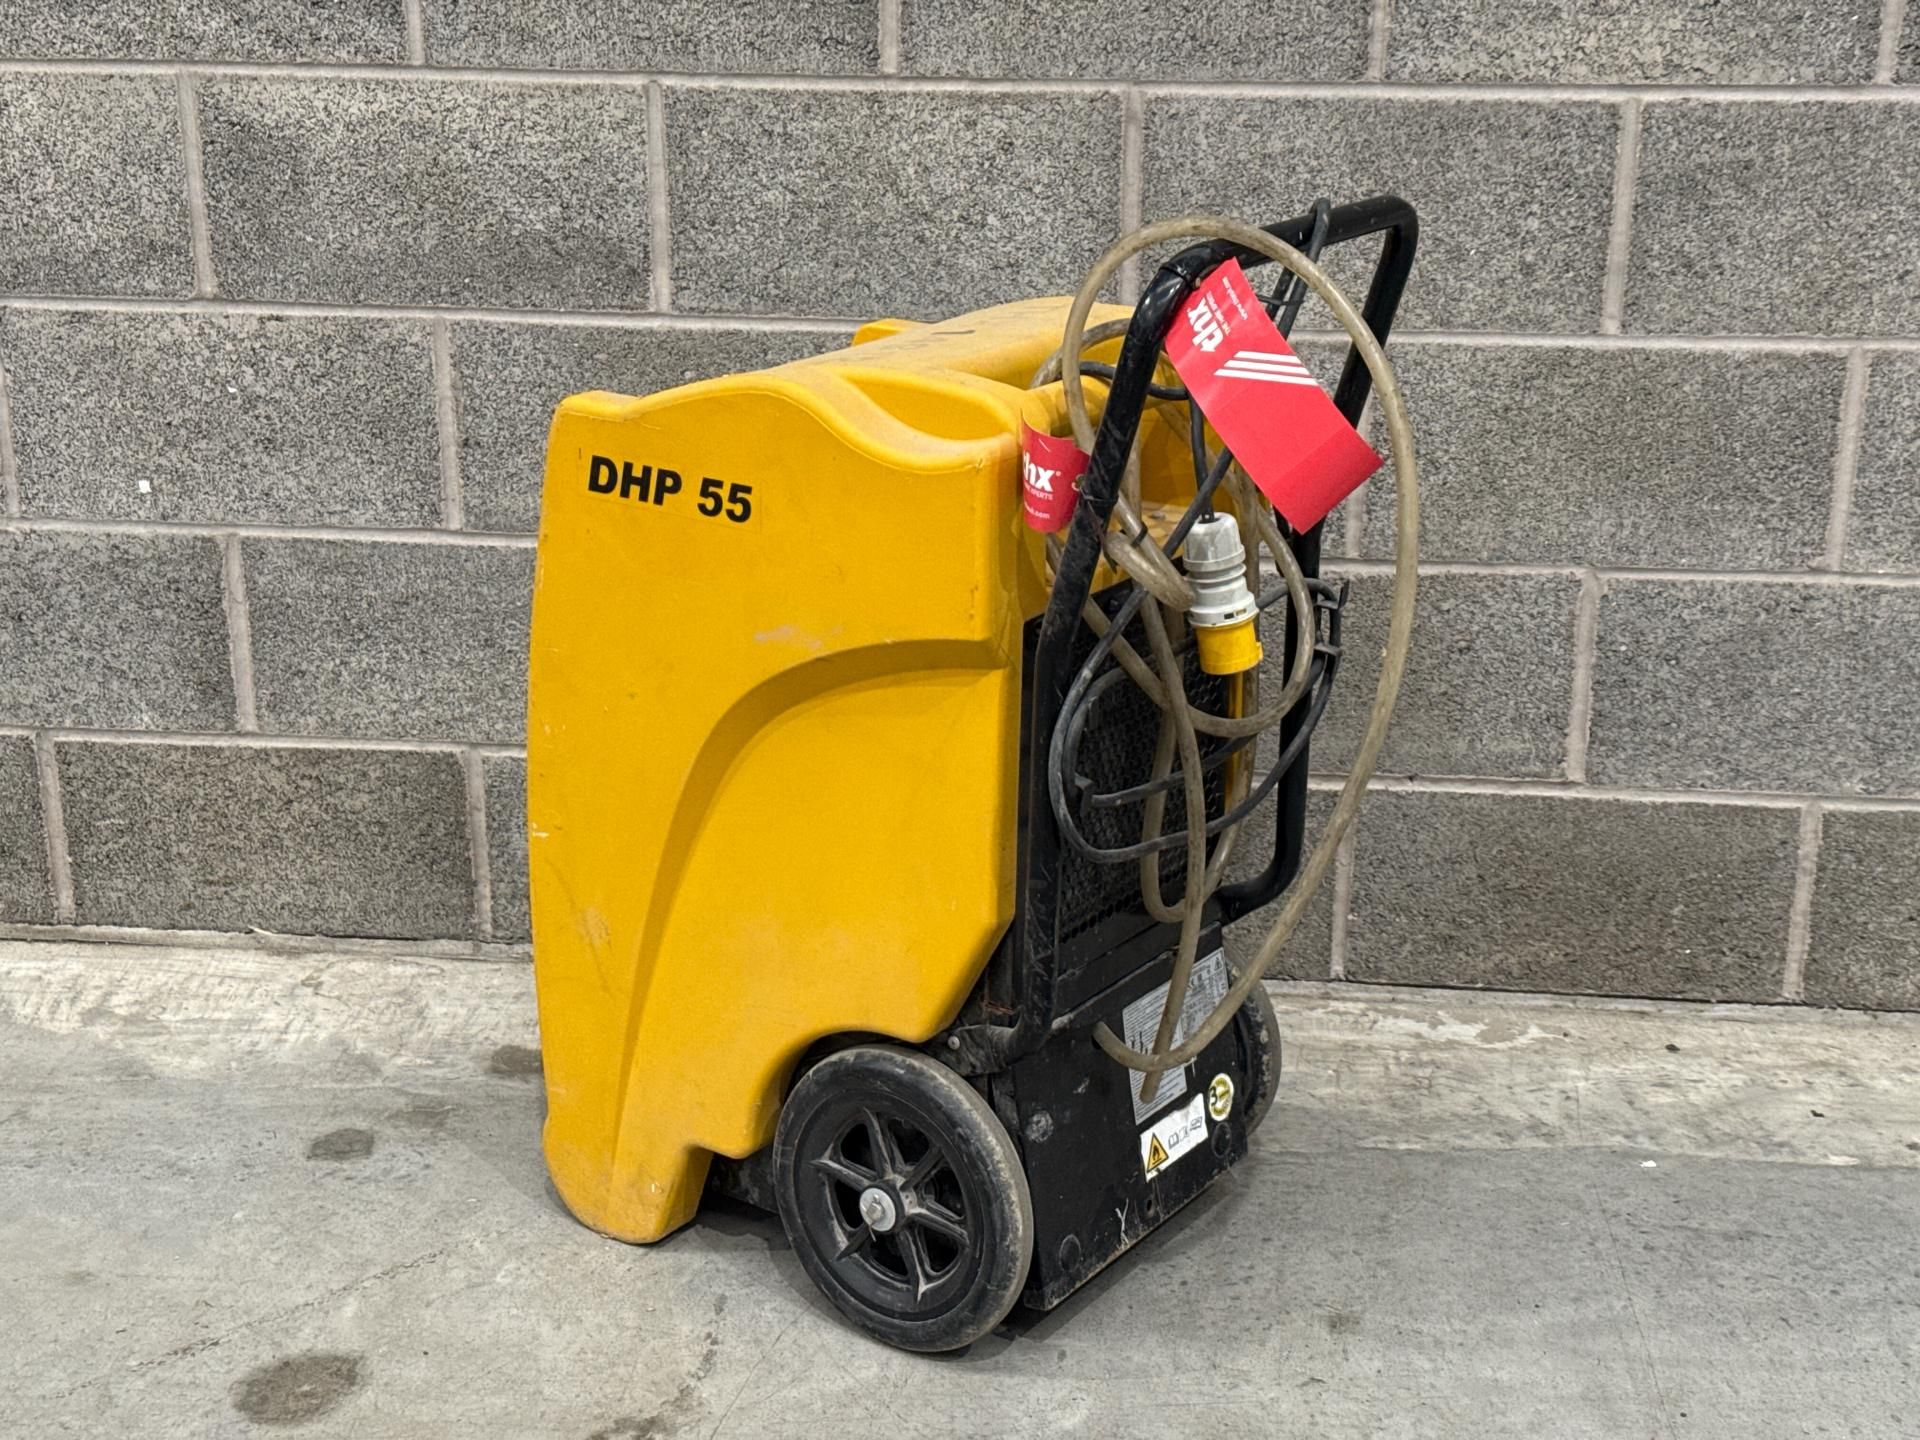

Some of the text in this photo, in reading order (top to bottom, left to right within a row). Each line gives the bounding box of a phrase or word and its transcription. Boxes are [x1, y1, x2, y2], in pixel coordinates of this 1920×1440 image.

[1187, 297, 1224, 352] thx
[588, 455, 753, 523] DHP 55
